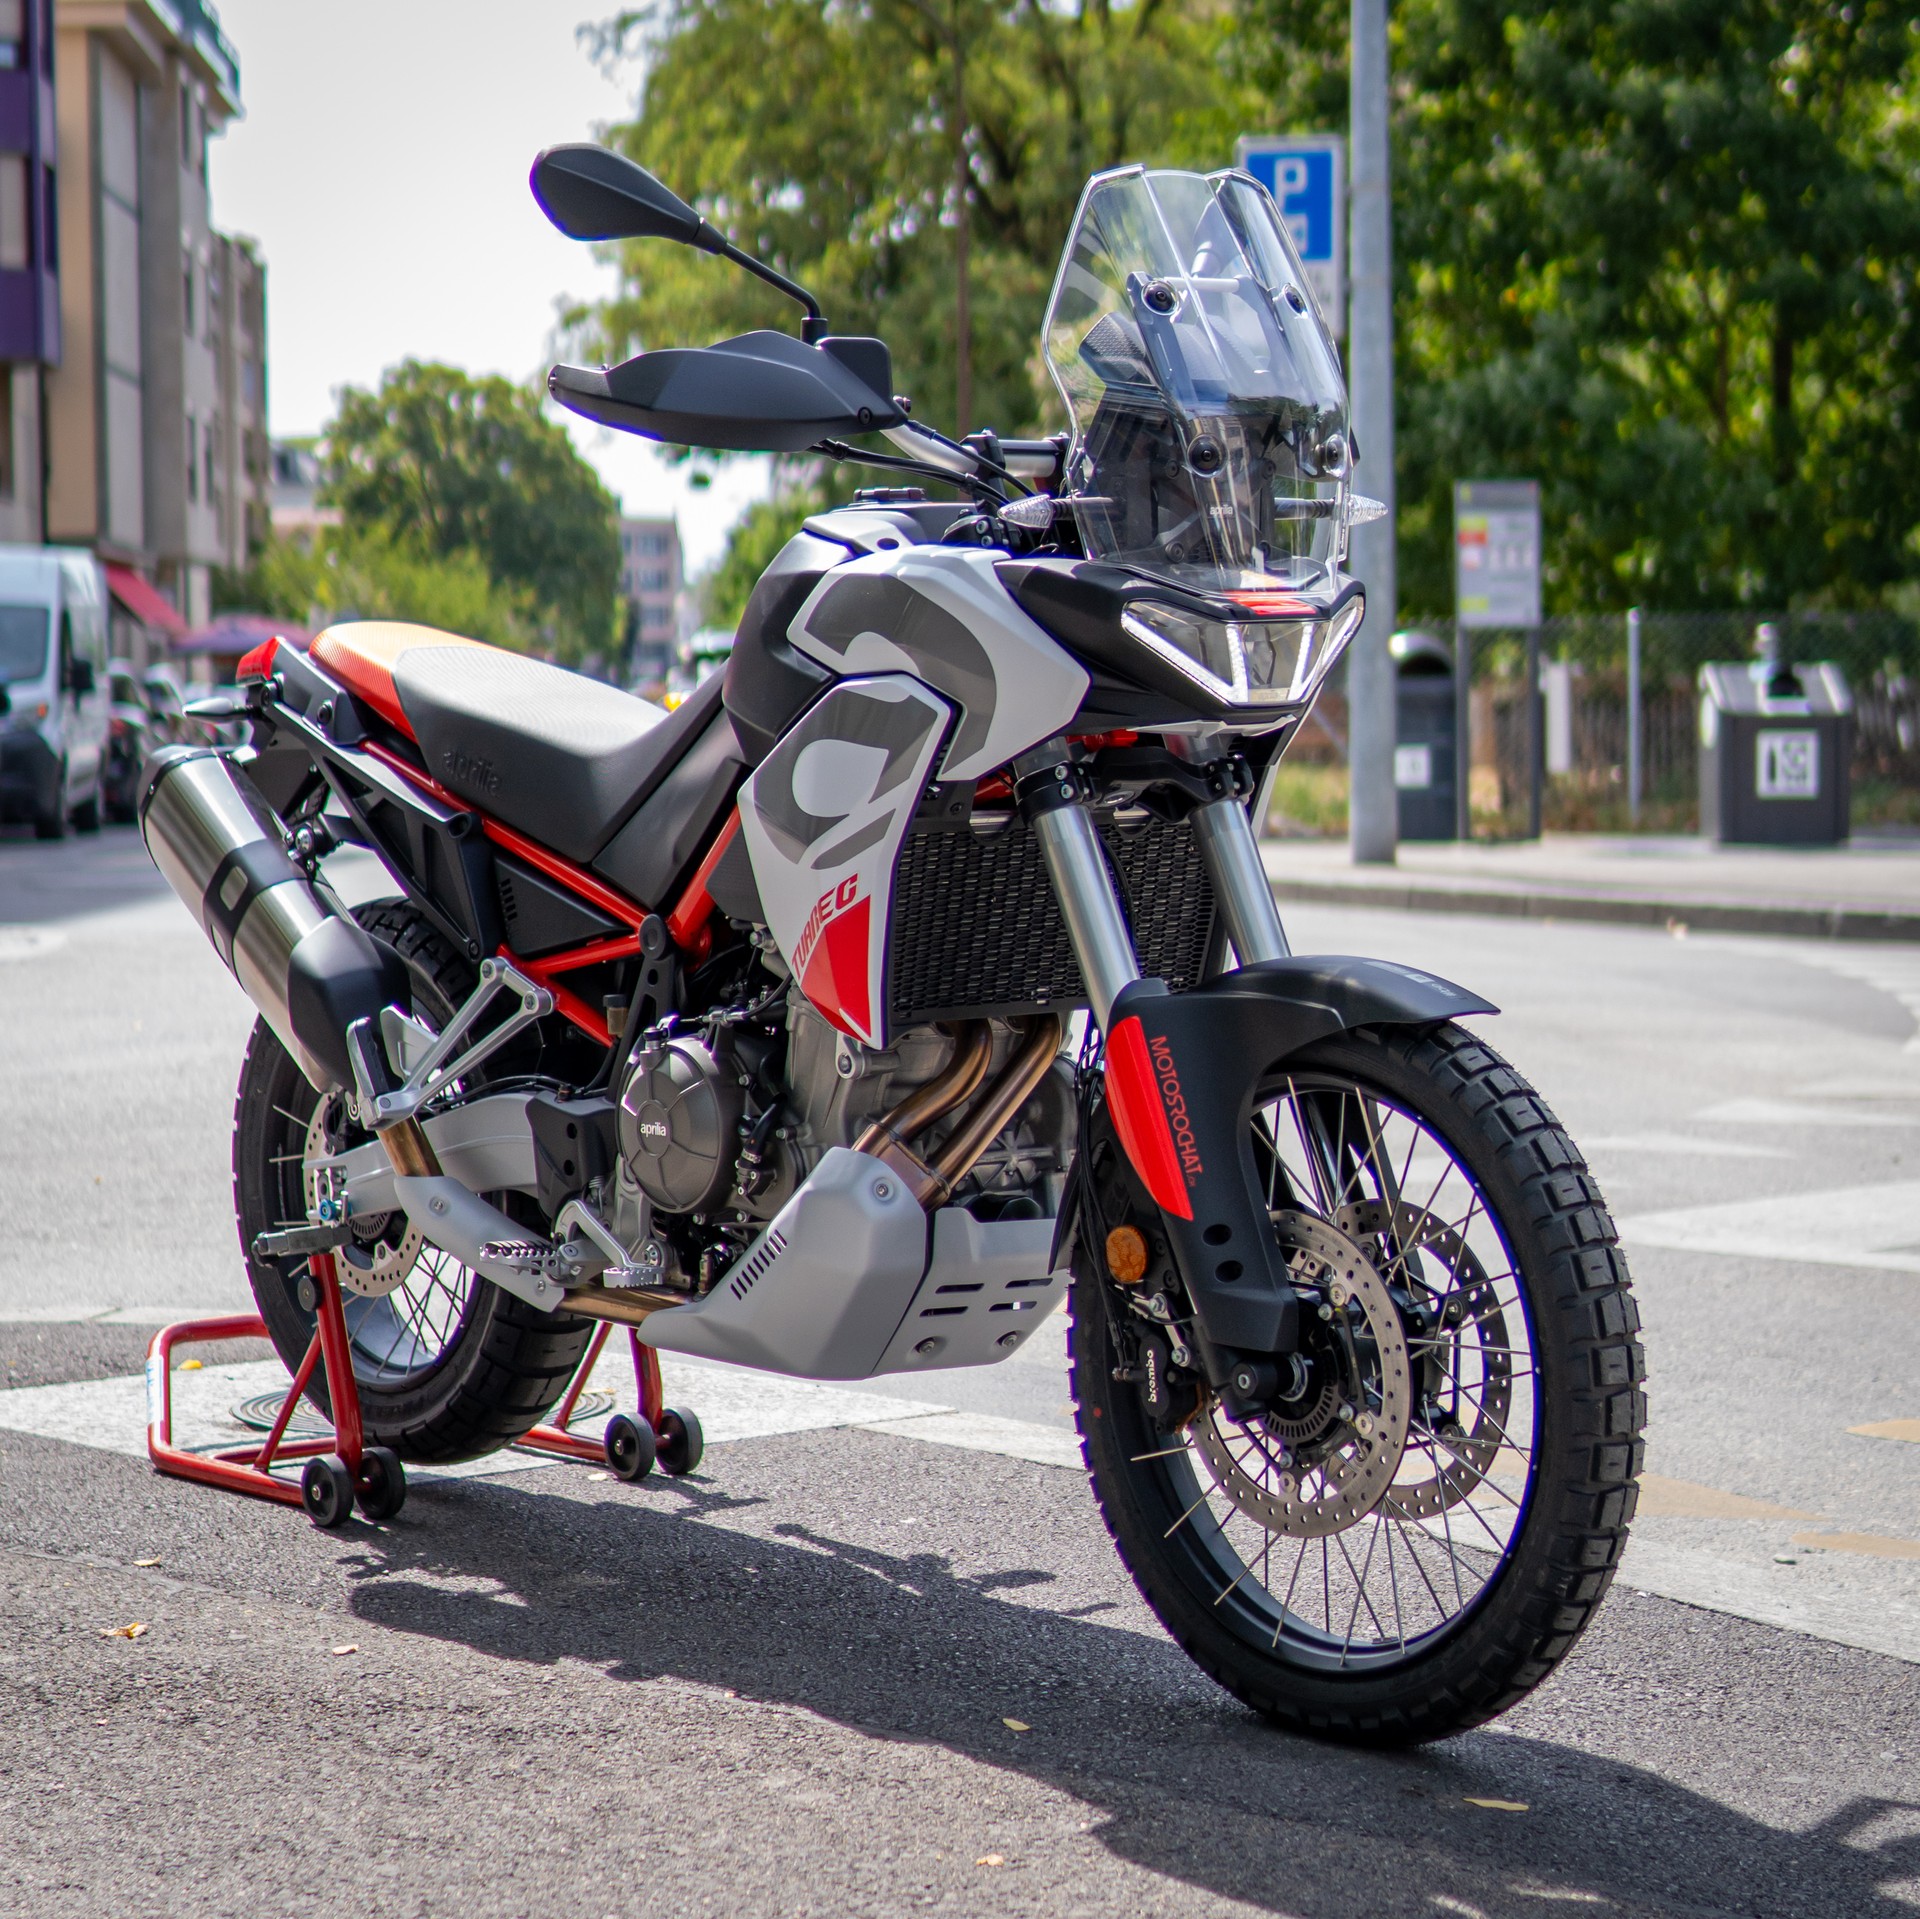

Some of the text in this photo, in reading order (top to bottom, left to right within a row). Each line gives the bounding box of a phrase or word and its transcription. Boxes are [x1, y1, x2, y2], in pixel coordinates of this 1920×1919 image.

[1274, 158, 1308, 214] P
[791, 872, 859, 981] TUAREG
[640, 1121, 667, 1138] aprilia
[1145, 1349, 1158, 1403] brembo
